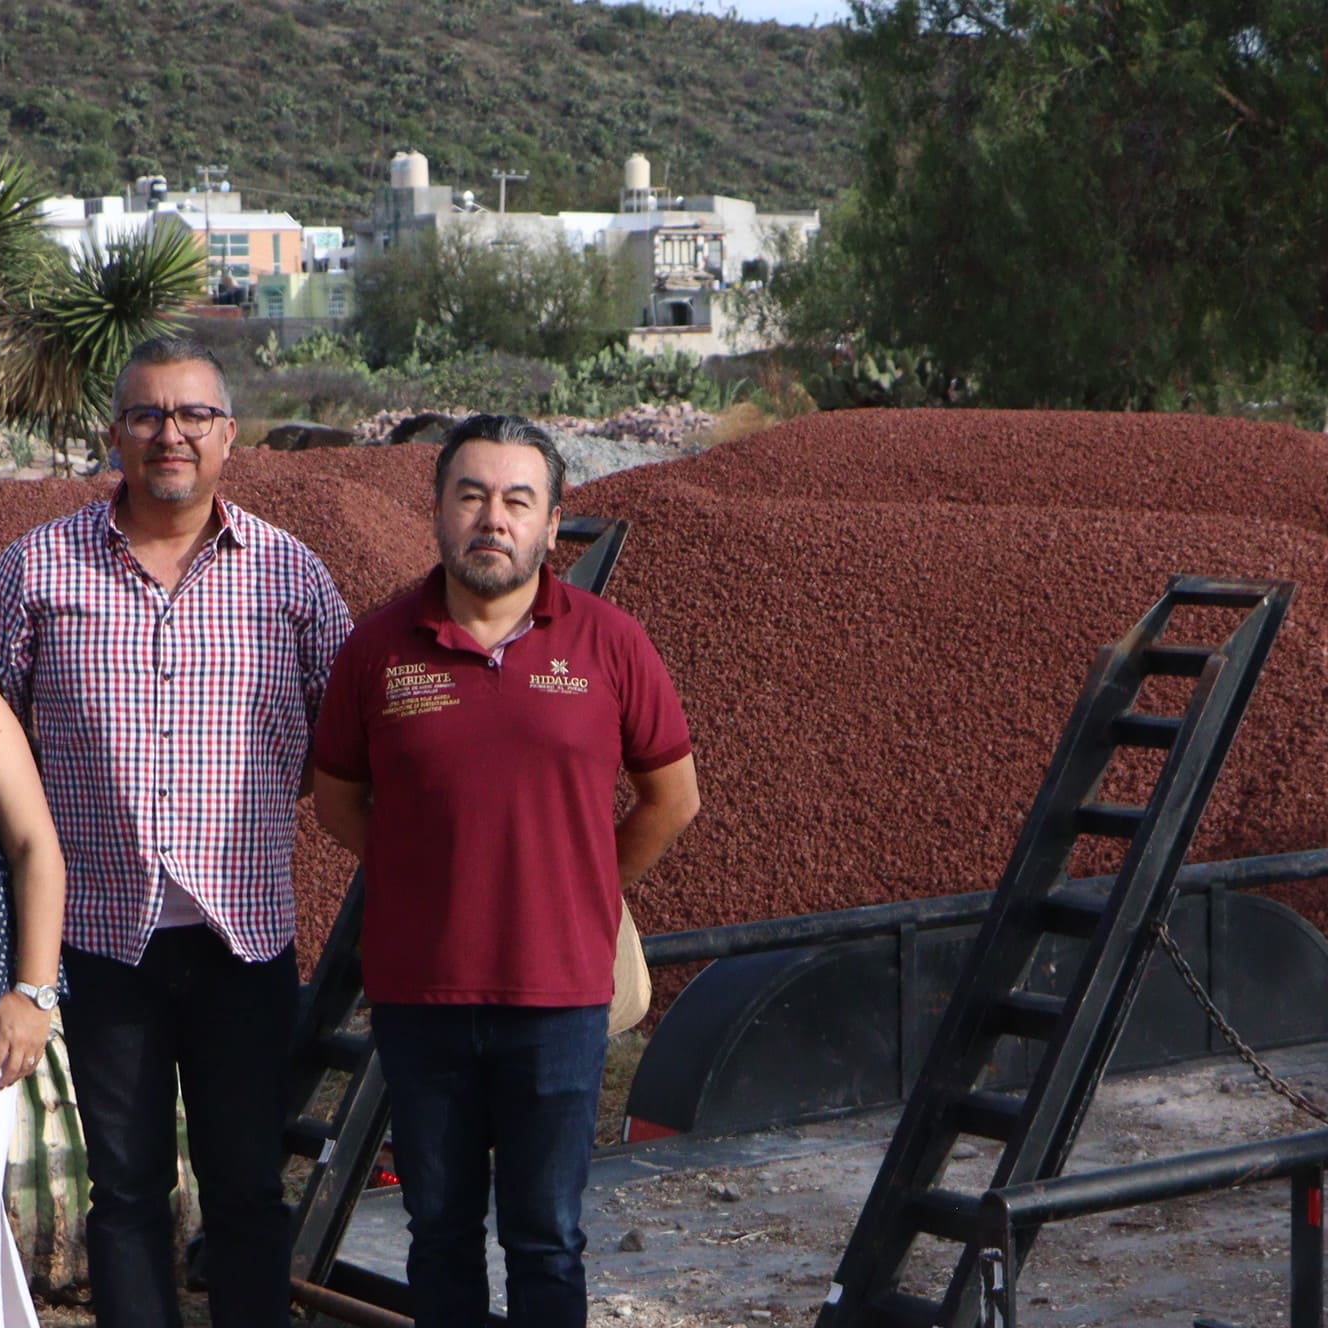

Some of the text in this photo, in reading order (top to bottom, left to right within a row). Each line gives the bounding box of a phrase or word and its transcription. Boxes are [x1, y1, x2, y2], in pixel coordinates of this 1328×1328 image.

[385, 662, 426, 678] MEDIO
[386, 672, 452, 690] AMBIENTE
[529, 674, 589, 688] HIDALGO
